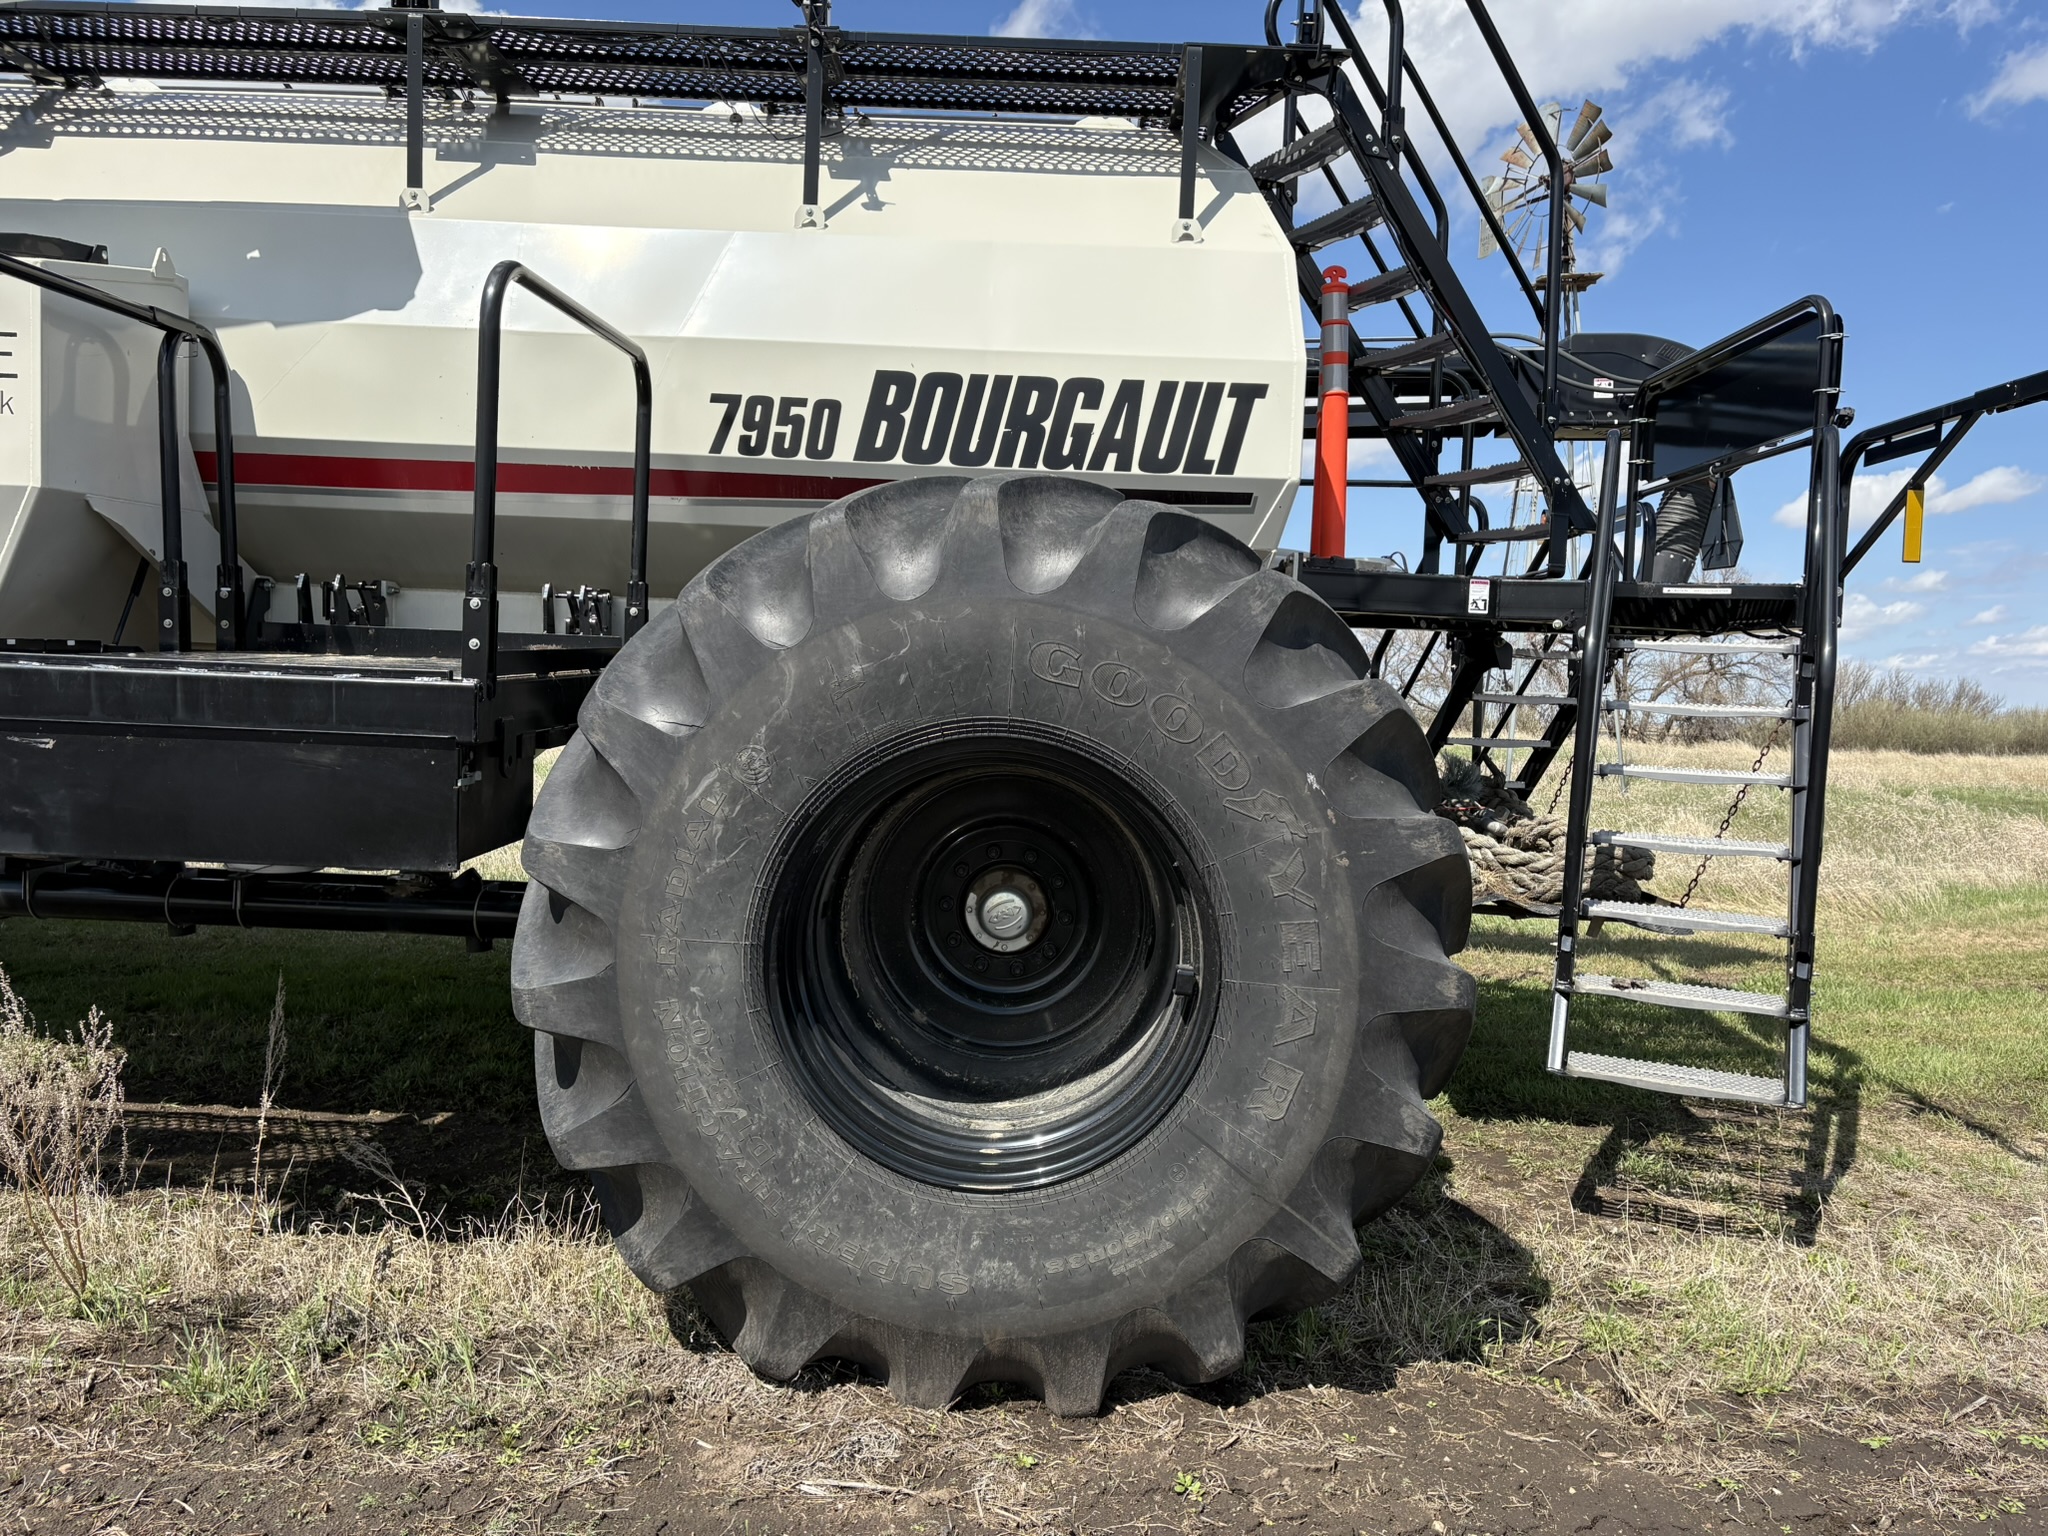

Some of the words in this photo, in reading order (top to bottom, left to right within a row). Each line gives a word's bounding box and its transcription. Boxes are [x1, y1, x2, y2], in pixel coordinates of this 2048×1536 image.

[709, 394, 842, 460] 7950
[855, 370, 1269, 475] BOURGAULT
[656, 789, 727, 966] RADIAL
[1028, 640, 1321, 1122] GOODYEAR
[654, 997, 790, 1217] TRACTION
[802, 1221, 969, 1295] SUPER
